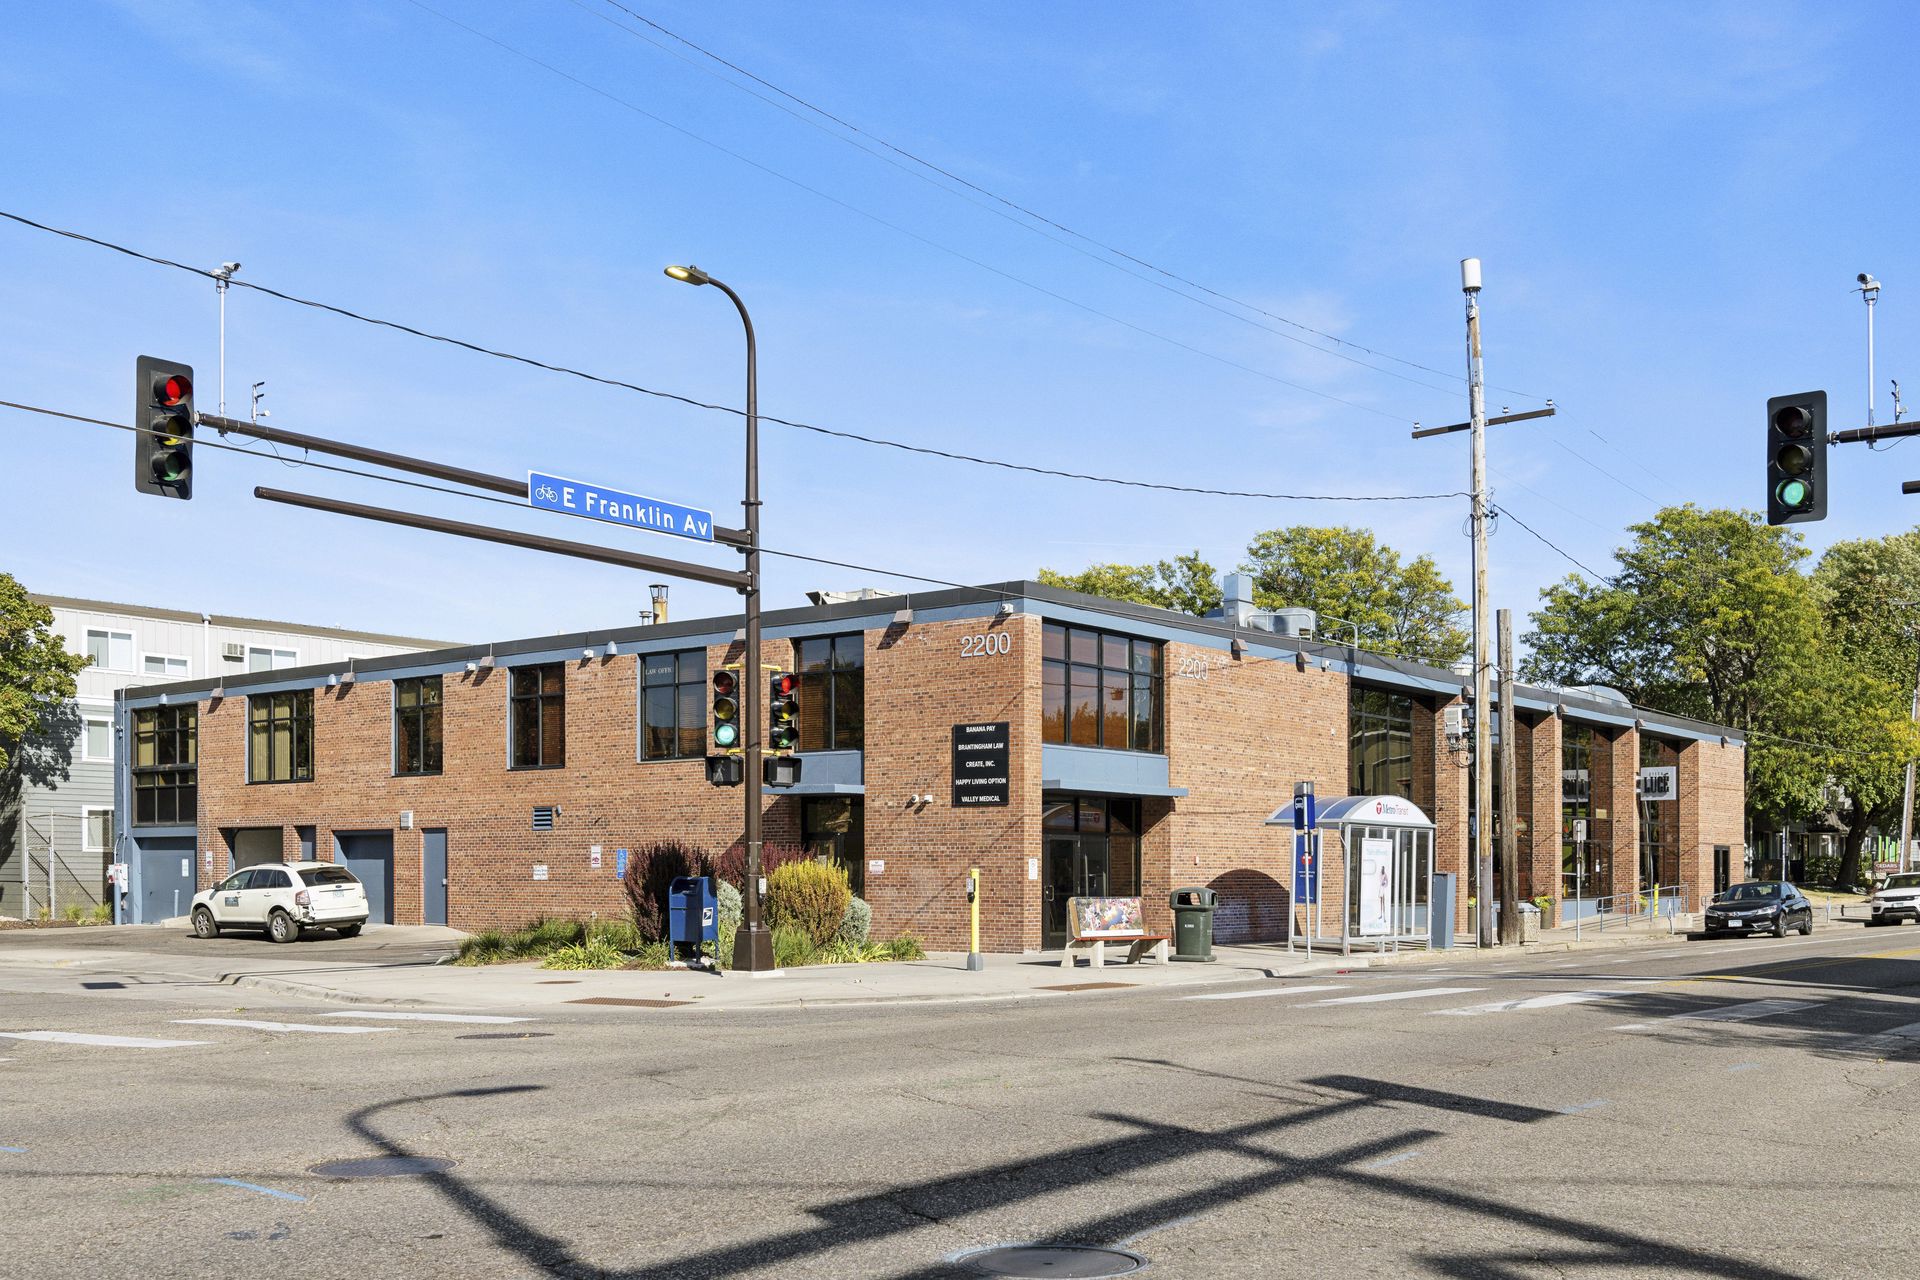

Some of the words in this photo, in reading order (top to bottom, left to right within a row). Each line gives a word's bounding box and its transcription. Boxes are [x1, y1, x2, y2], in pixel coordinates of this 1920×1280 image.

[563, 487, 576, 508] E
[585, 491, 675, 529] Franklin
[683, 514, 708, 536] Av
[961, 632, 1010, 658] 2200
[1178, 657, 1208, 680] 2200
[958, 743, 992, 751] BRANTINGHAM
[955, 778, 971, 786] HAPPY
[987, 777, 1006, 785] OPTION
